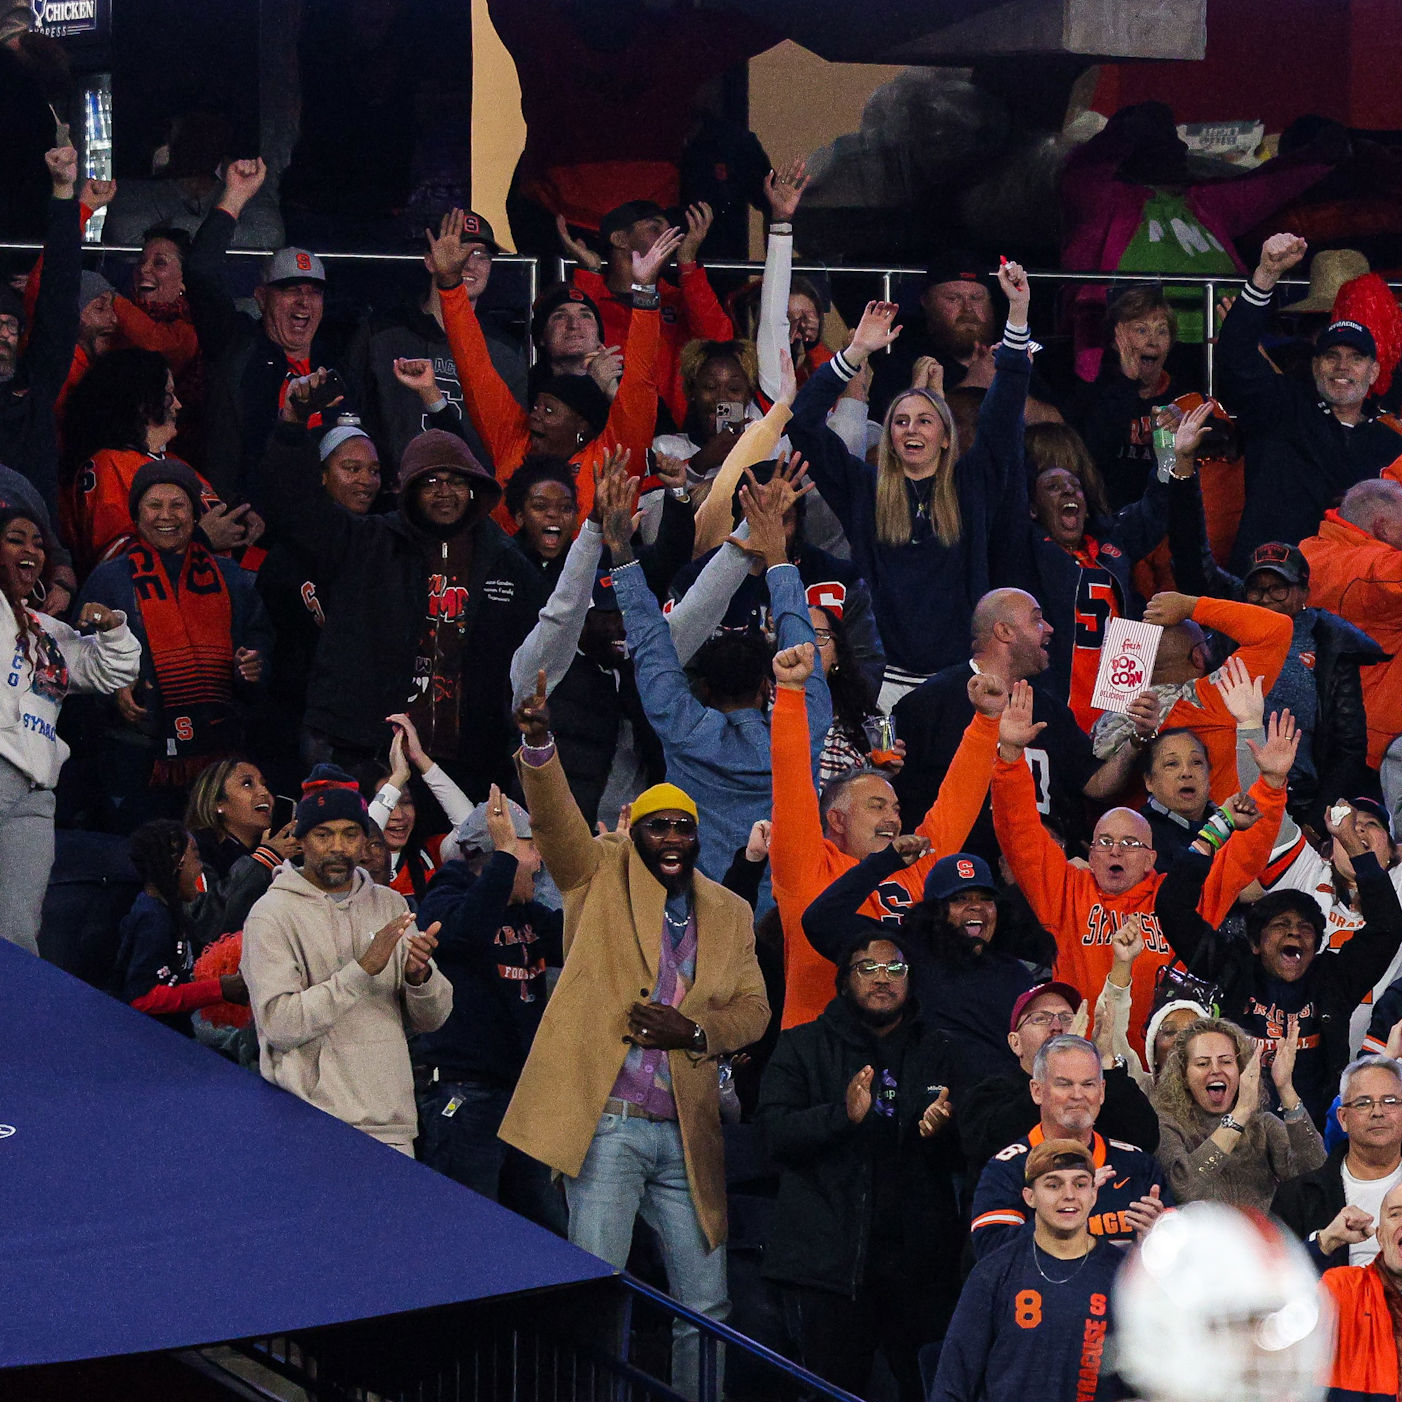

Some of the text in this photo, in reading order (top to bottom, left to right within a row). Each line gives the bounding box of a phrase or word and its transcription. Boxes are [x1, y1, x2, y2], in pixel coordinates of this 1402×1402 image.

[45, 0, 95, 22] CHICKEN
[464, 216, 480, 235] S
[296, 252, 313, 271] S
[1121, 638, 1142, 652] fresh
[1111, 655, 1137, 671] POP
[1110, 667, 1144, 688] CORN
[174, 715, 195, 741] S
[956, 859, 976, 880] S
[1080, 903, 1169, 954] SYSE
[1087, 1210, 1132, 1236] NGE
[1014, 1289, 1043, 1330] 8
